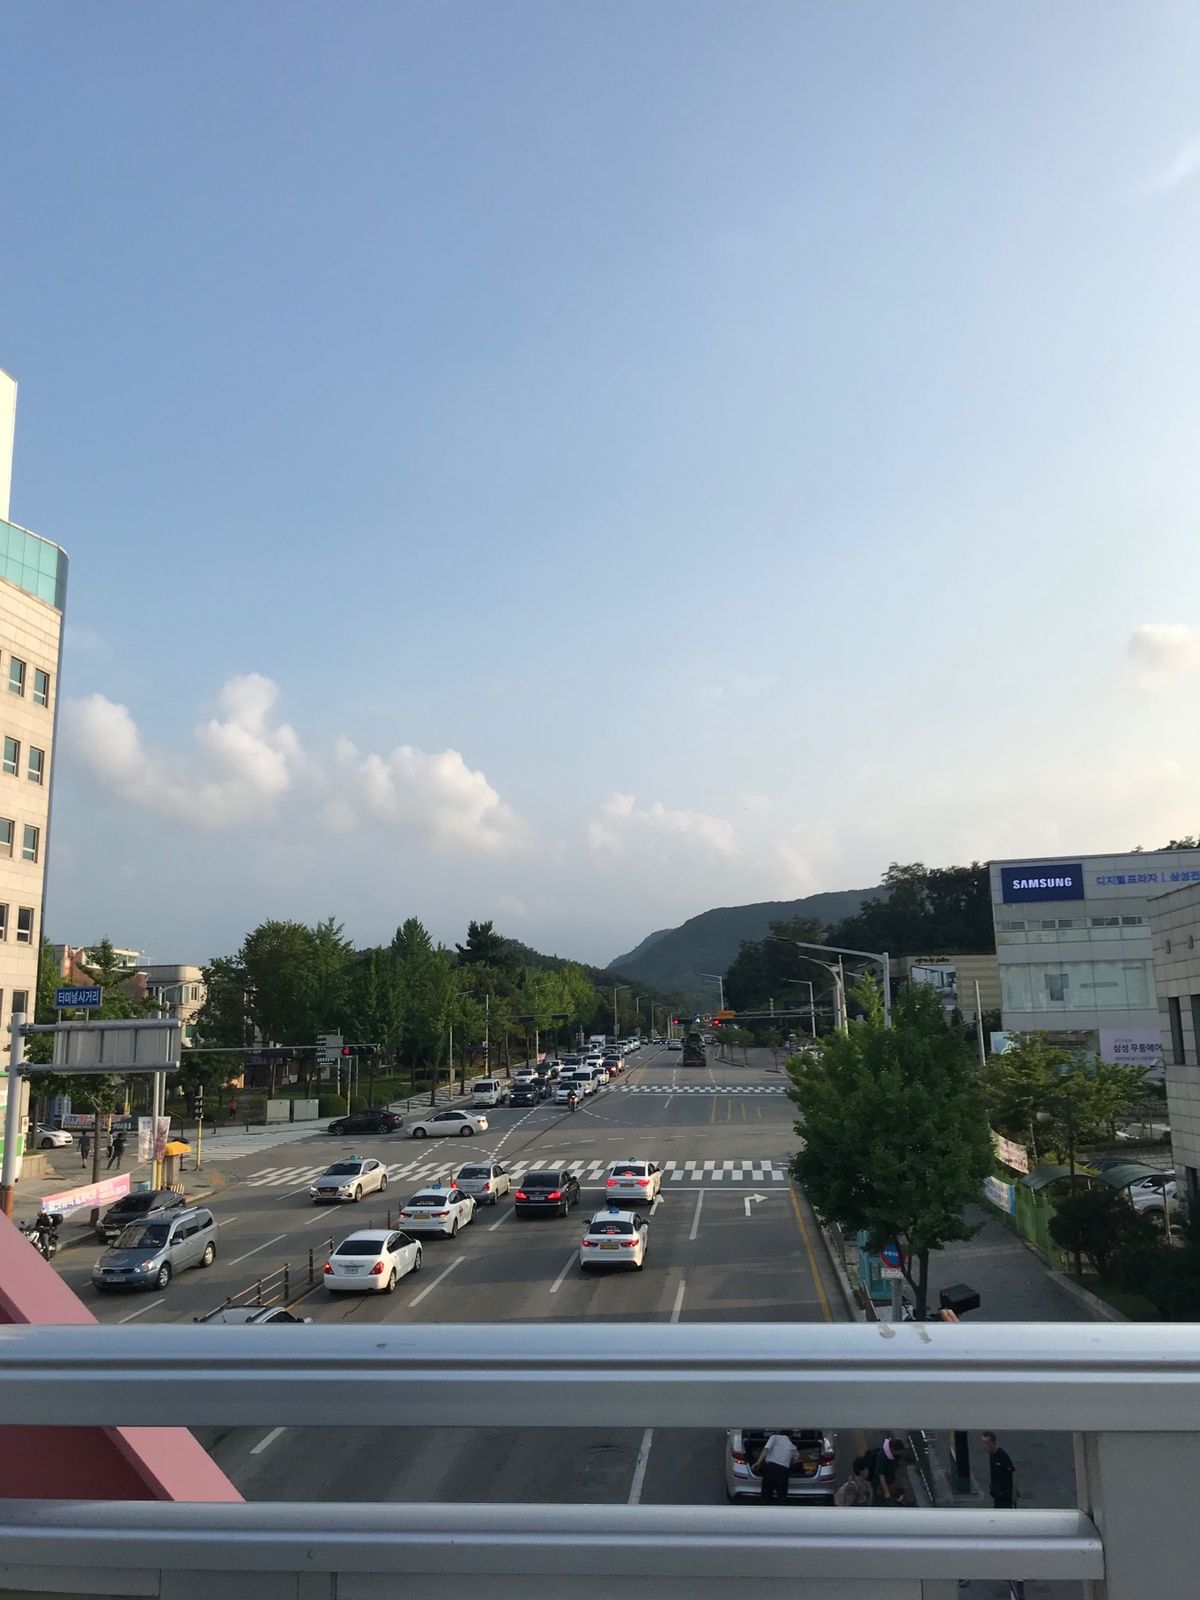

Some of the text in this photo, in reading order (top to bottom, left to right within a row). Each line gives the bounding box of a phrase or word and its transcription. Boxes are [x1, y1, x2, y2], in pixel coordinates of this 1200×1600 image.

[1013, 877, 1073, 889] SAMSUNG
[1096, 872, 1157, 886] 디지털프라자
[58, 989, 99, 1005] 터미널사거리
